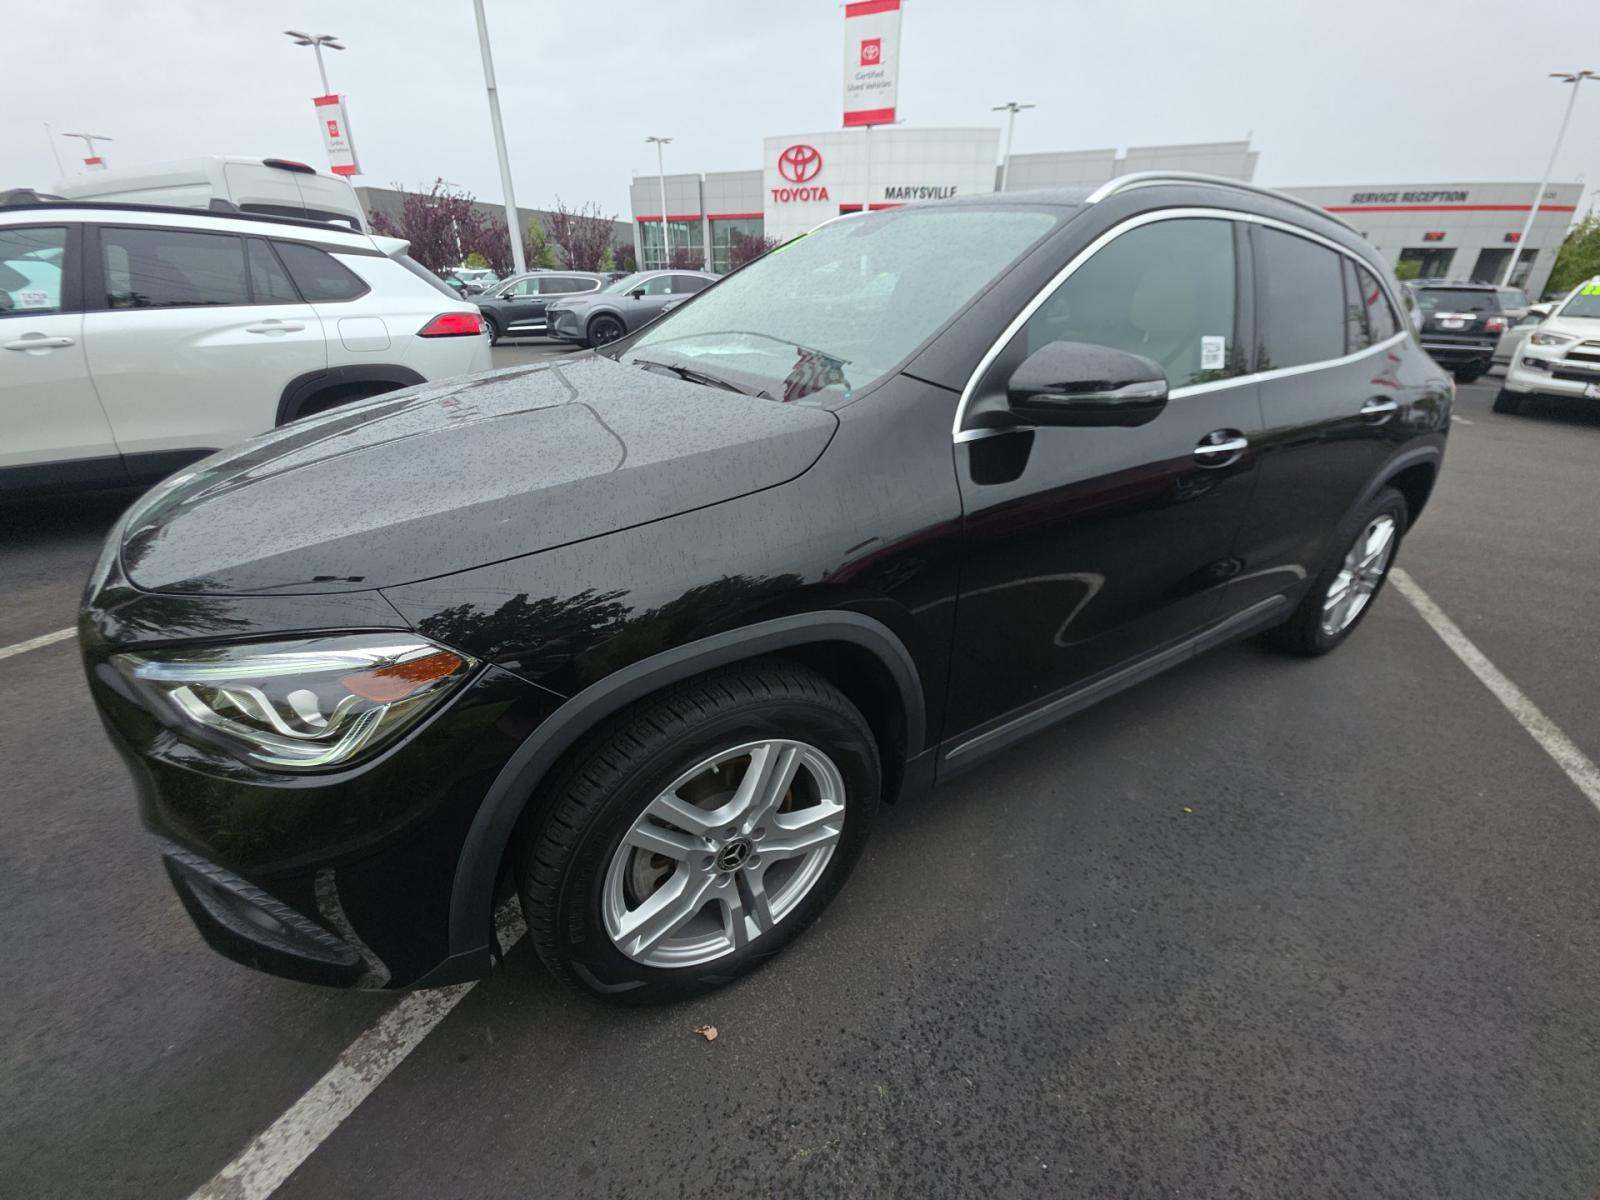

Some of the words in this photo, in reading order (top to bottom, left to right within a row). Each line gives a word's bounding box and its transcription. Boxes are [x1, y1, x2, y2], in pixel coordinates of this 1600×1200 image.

[771, 187, 829, 202] TOYOTA
[885, 186, 957, 200] MARYSVILLE
[1352, 192, 1398, 203] SERVICE
[1401, 190, 1469, 202] RECEPTION
